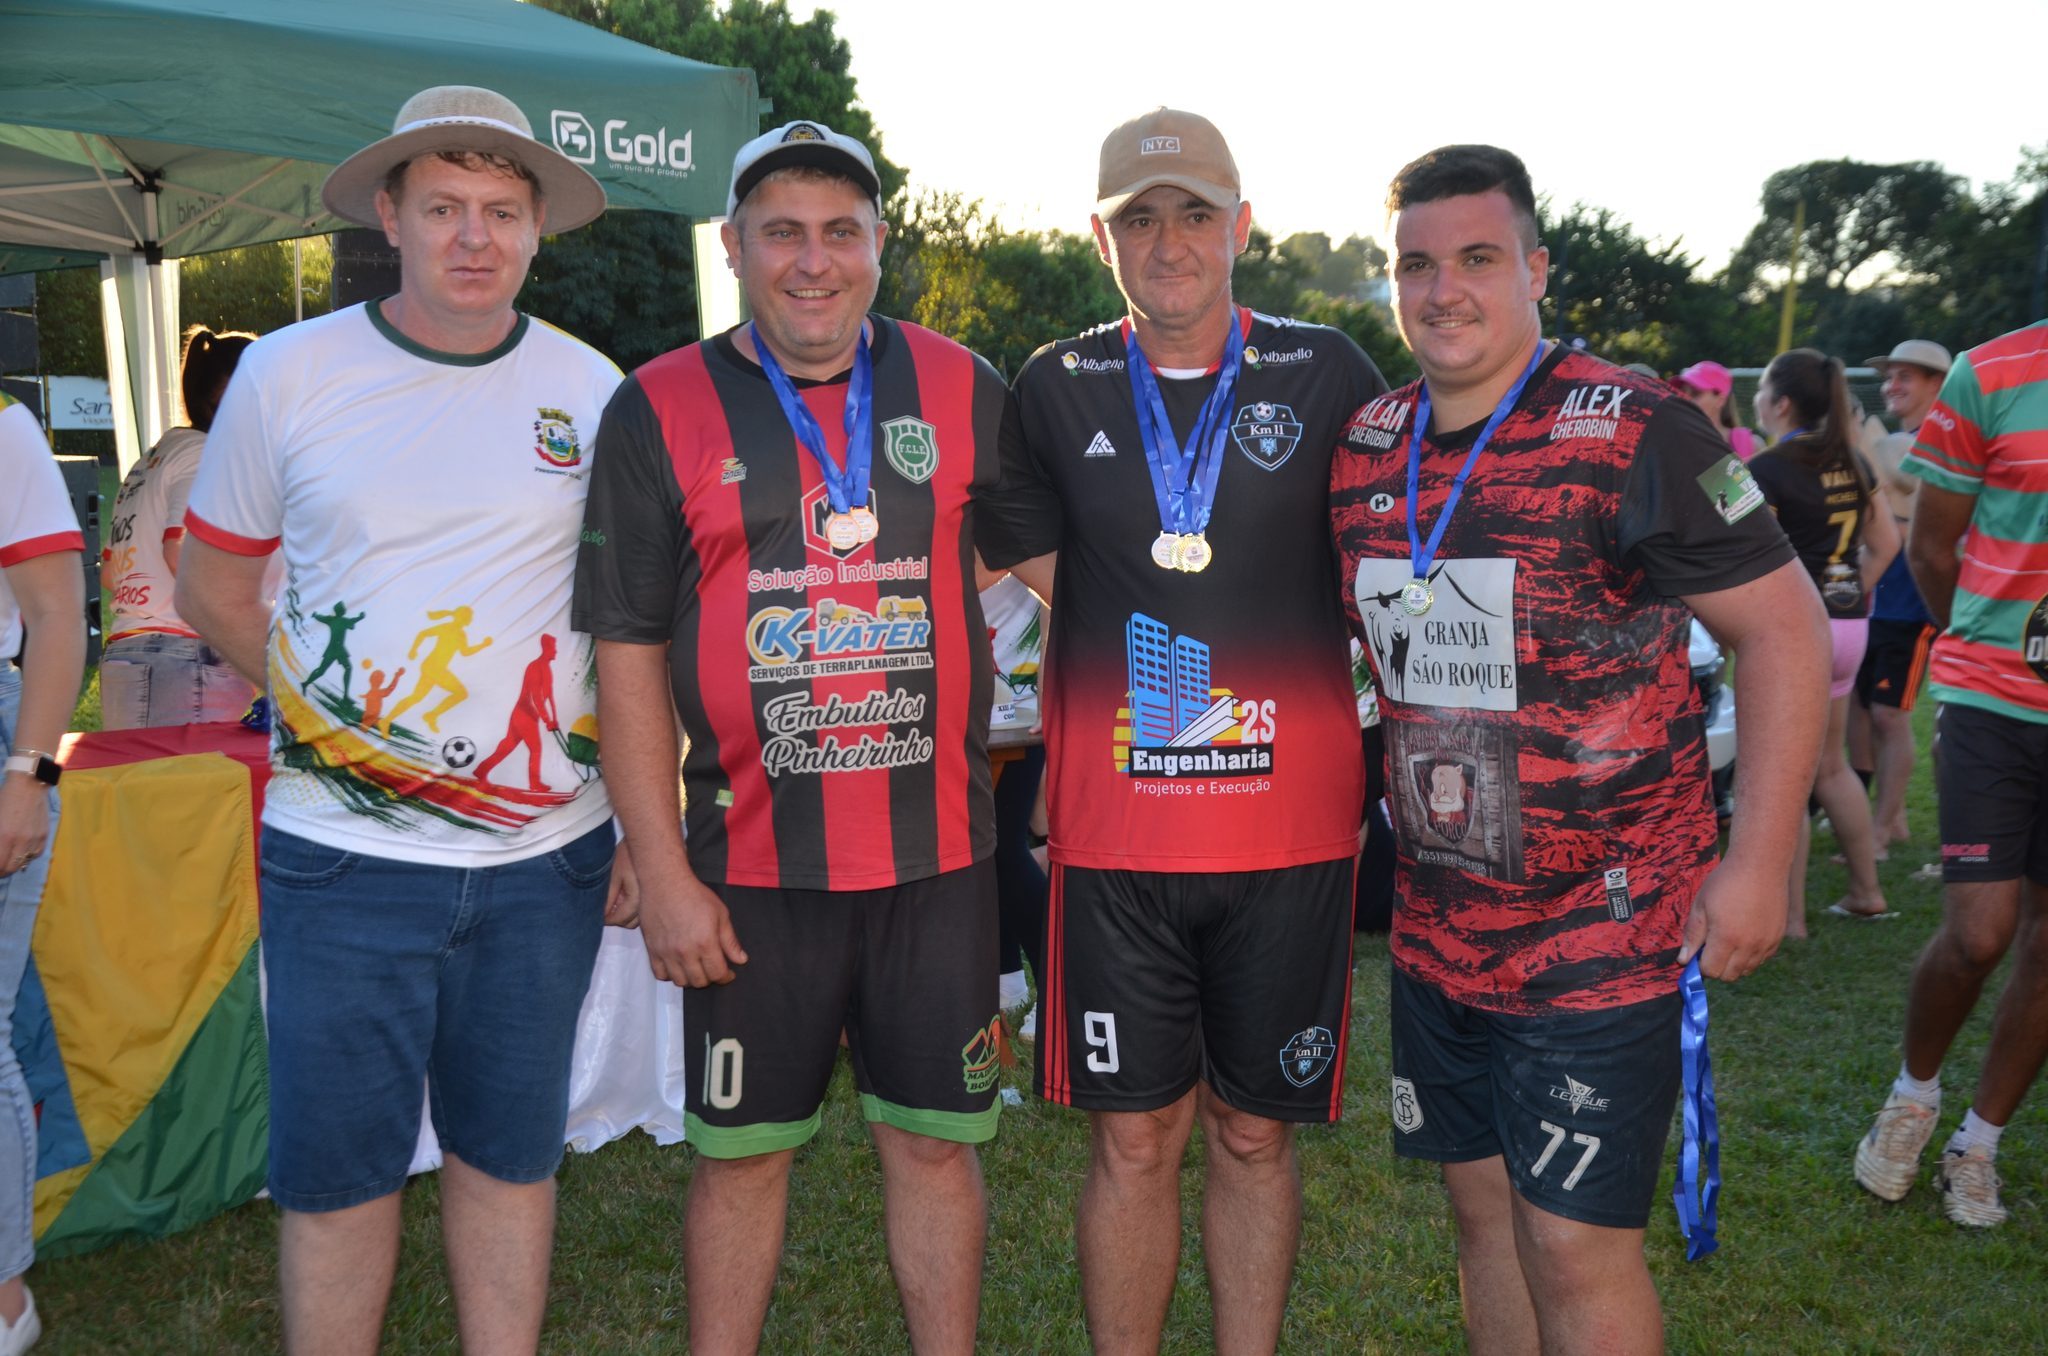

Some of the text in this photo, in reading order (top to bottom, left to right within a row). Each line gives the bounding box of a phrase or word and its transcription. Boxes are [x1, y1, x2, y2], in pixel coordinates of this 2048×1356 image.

[604, 119, 692, 170] Gold
[1146, 140, 1175, 150] NYC
[1260, 347, 1313, 363] Albarello
[1355, 398, 1411, 433] ALAN
[1556, 385, 1633, 421] ALEX
[1250, 424, 1272, 436] Km
[1348, 425, 1397, 449] CHEROBINI
[1549, 419, 1618, 440] CHEROBINI
[1827, 509, 1858, 564] 7
[748, 556, 928, 592] Solução Industrial
[1425, 621, 1489, 649] GRANJA
[751, 665, 800, 681] SERVIÇOS
[803, 664, 817, 675] DE
[820, 656, 909, 674] TERRAPLANAGEM
[1412, 654, 1513, 694] SÃO ROQUE
[766, 689, 924, 733] Embutidos
[1240, 699, 1276, 744] 2S
[764, 730, 933, 775] Pinheirinho
[1133, 748, 1270, 777] Engenharia
[1135, 778, 1270, 797] Projetos e Execução
[1084, 1011, 1119, 1073] 9
[1549, 1088, 1611, 1108] LEAGUE
[1531, 1120, 1601, 1191] 77
